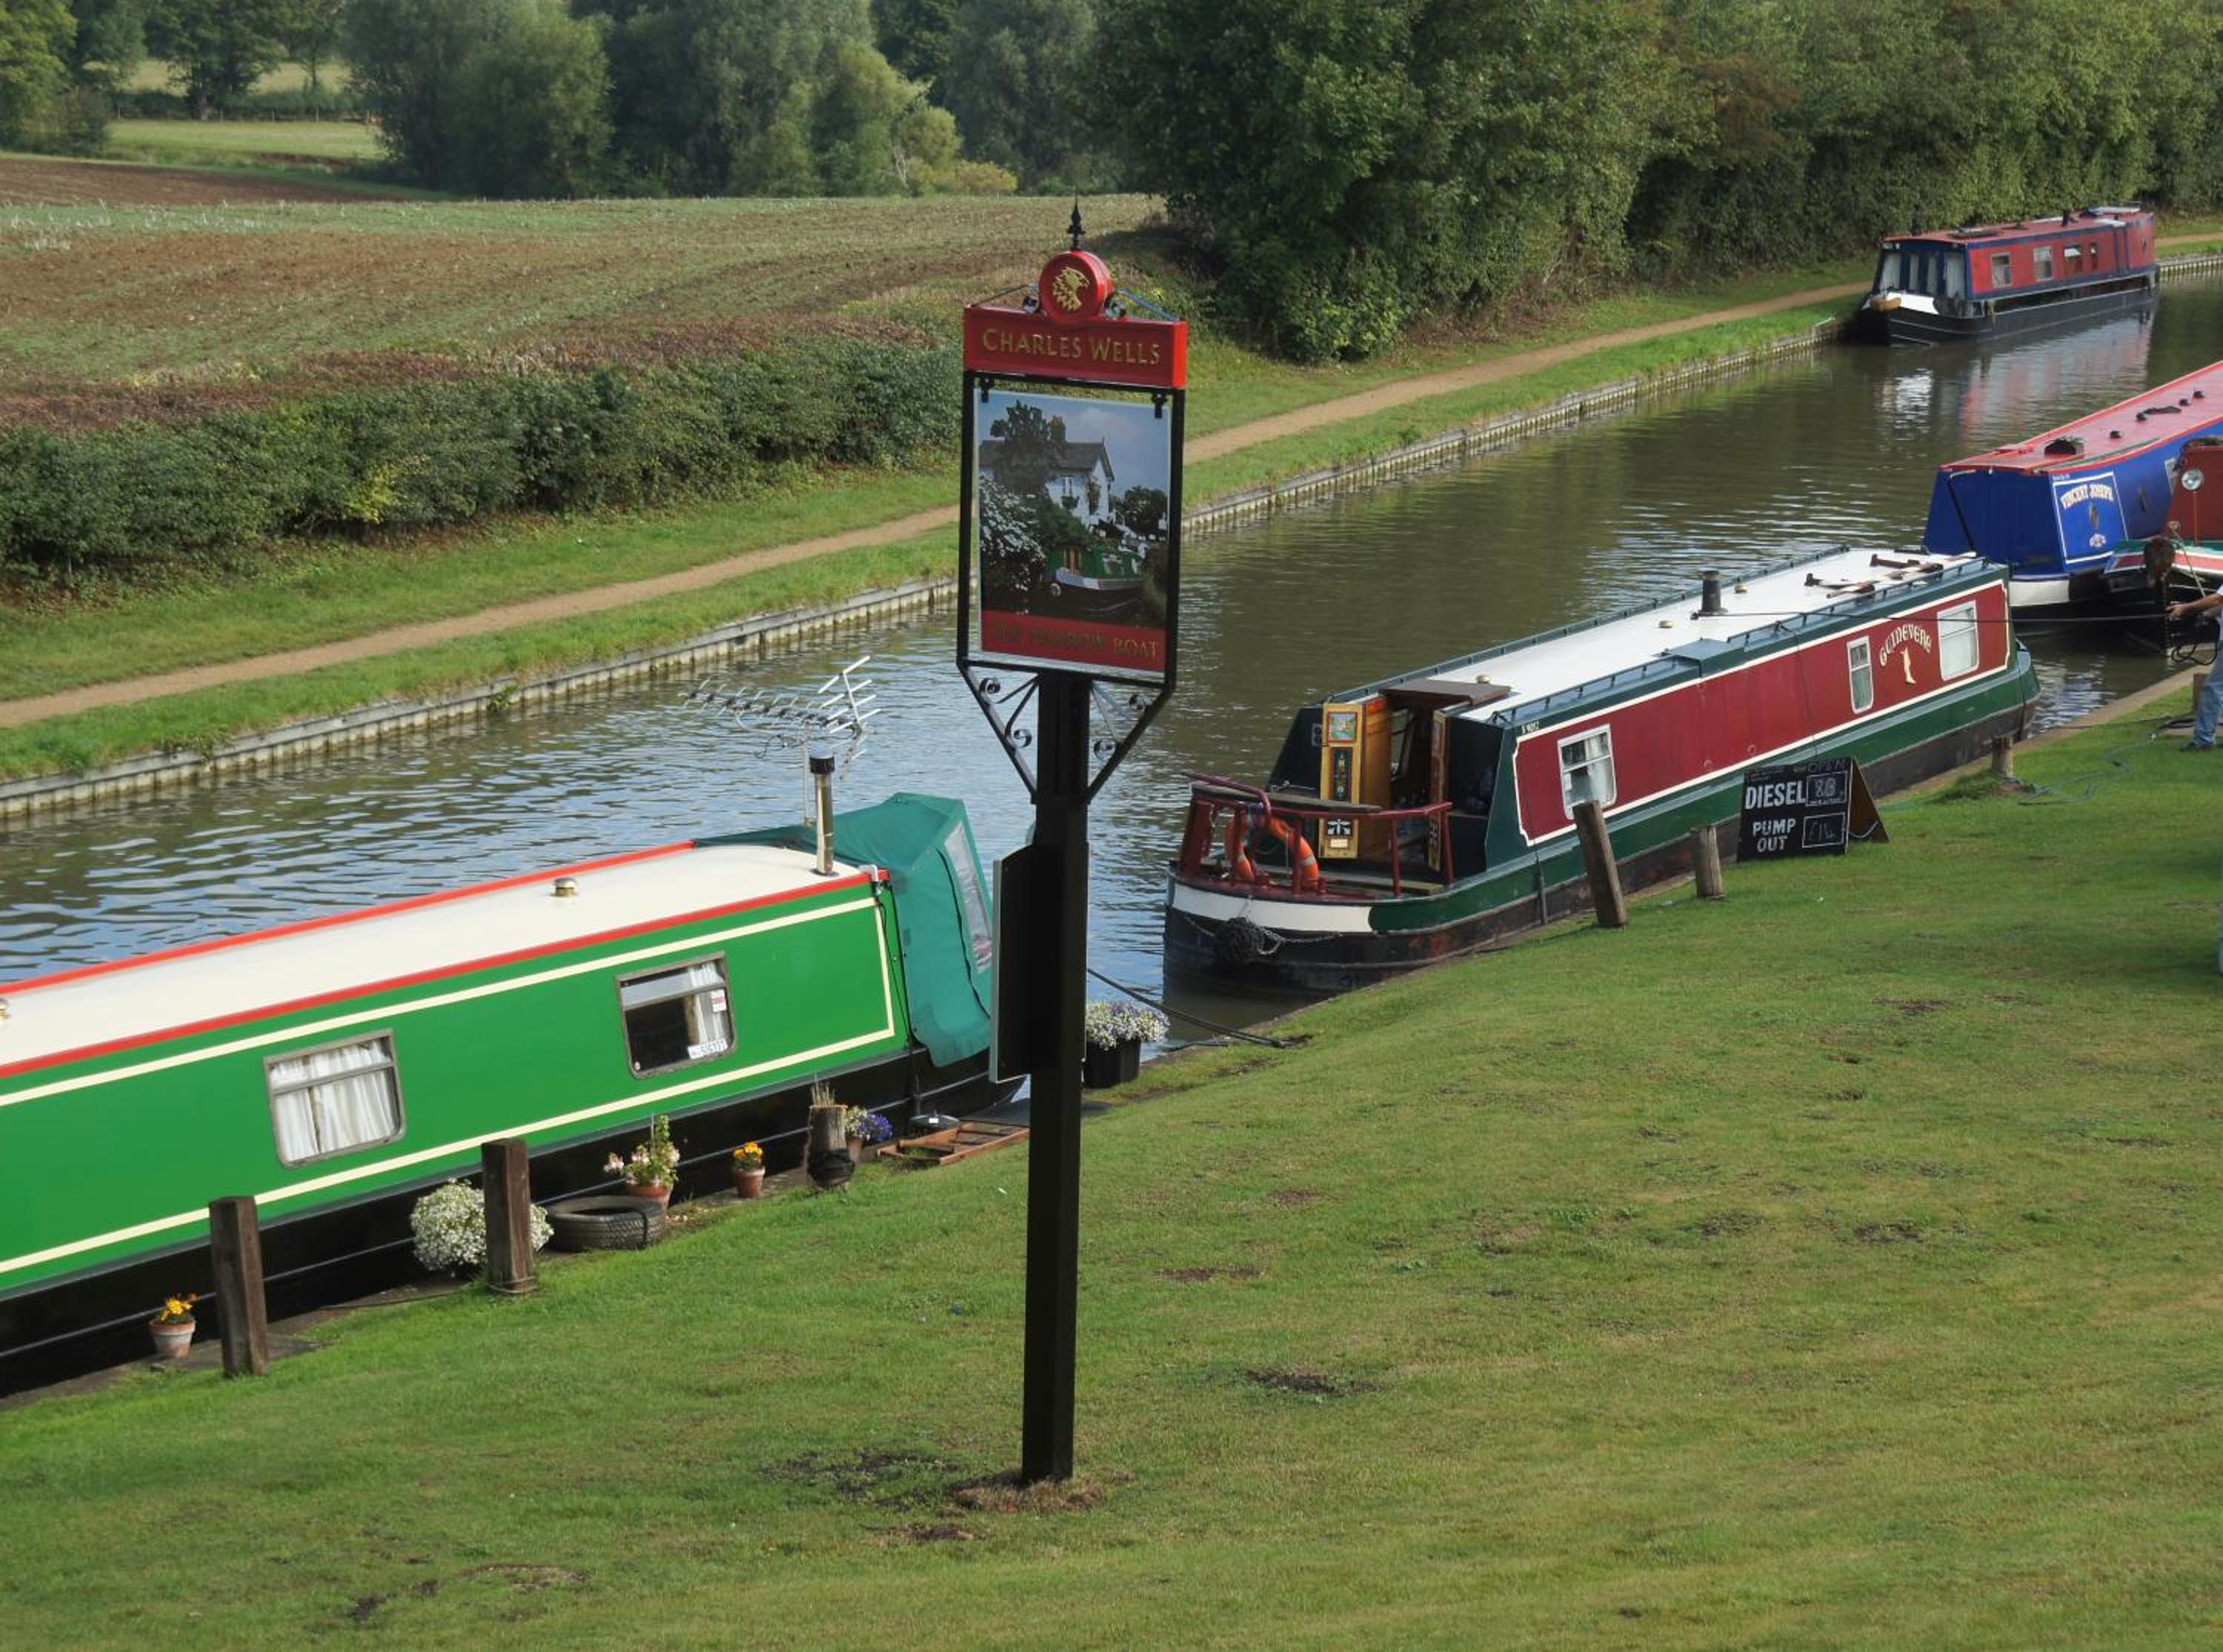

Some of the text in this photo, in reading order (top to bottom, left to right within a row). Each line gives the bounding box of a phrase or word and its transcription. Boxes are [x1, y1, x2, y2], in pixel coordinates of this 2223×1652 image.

[983, 327, 1161, 364] CHARLES WELLS
[1114, 637, 1157, 658] BOAT
[1745, 780, 1806, 809] DIESEL
[1752, 819, 1797, 838] PUMP
[1757, 835, 1788, 853] OUT
